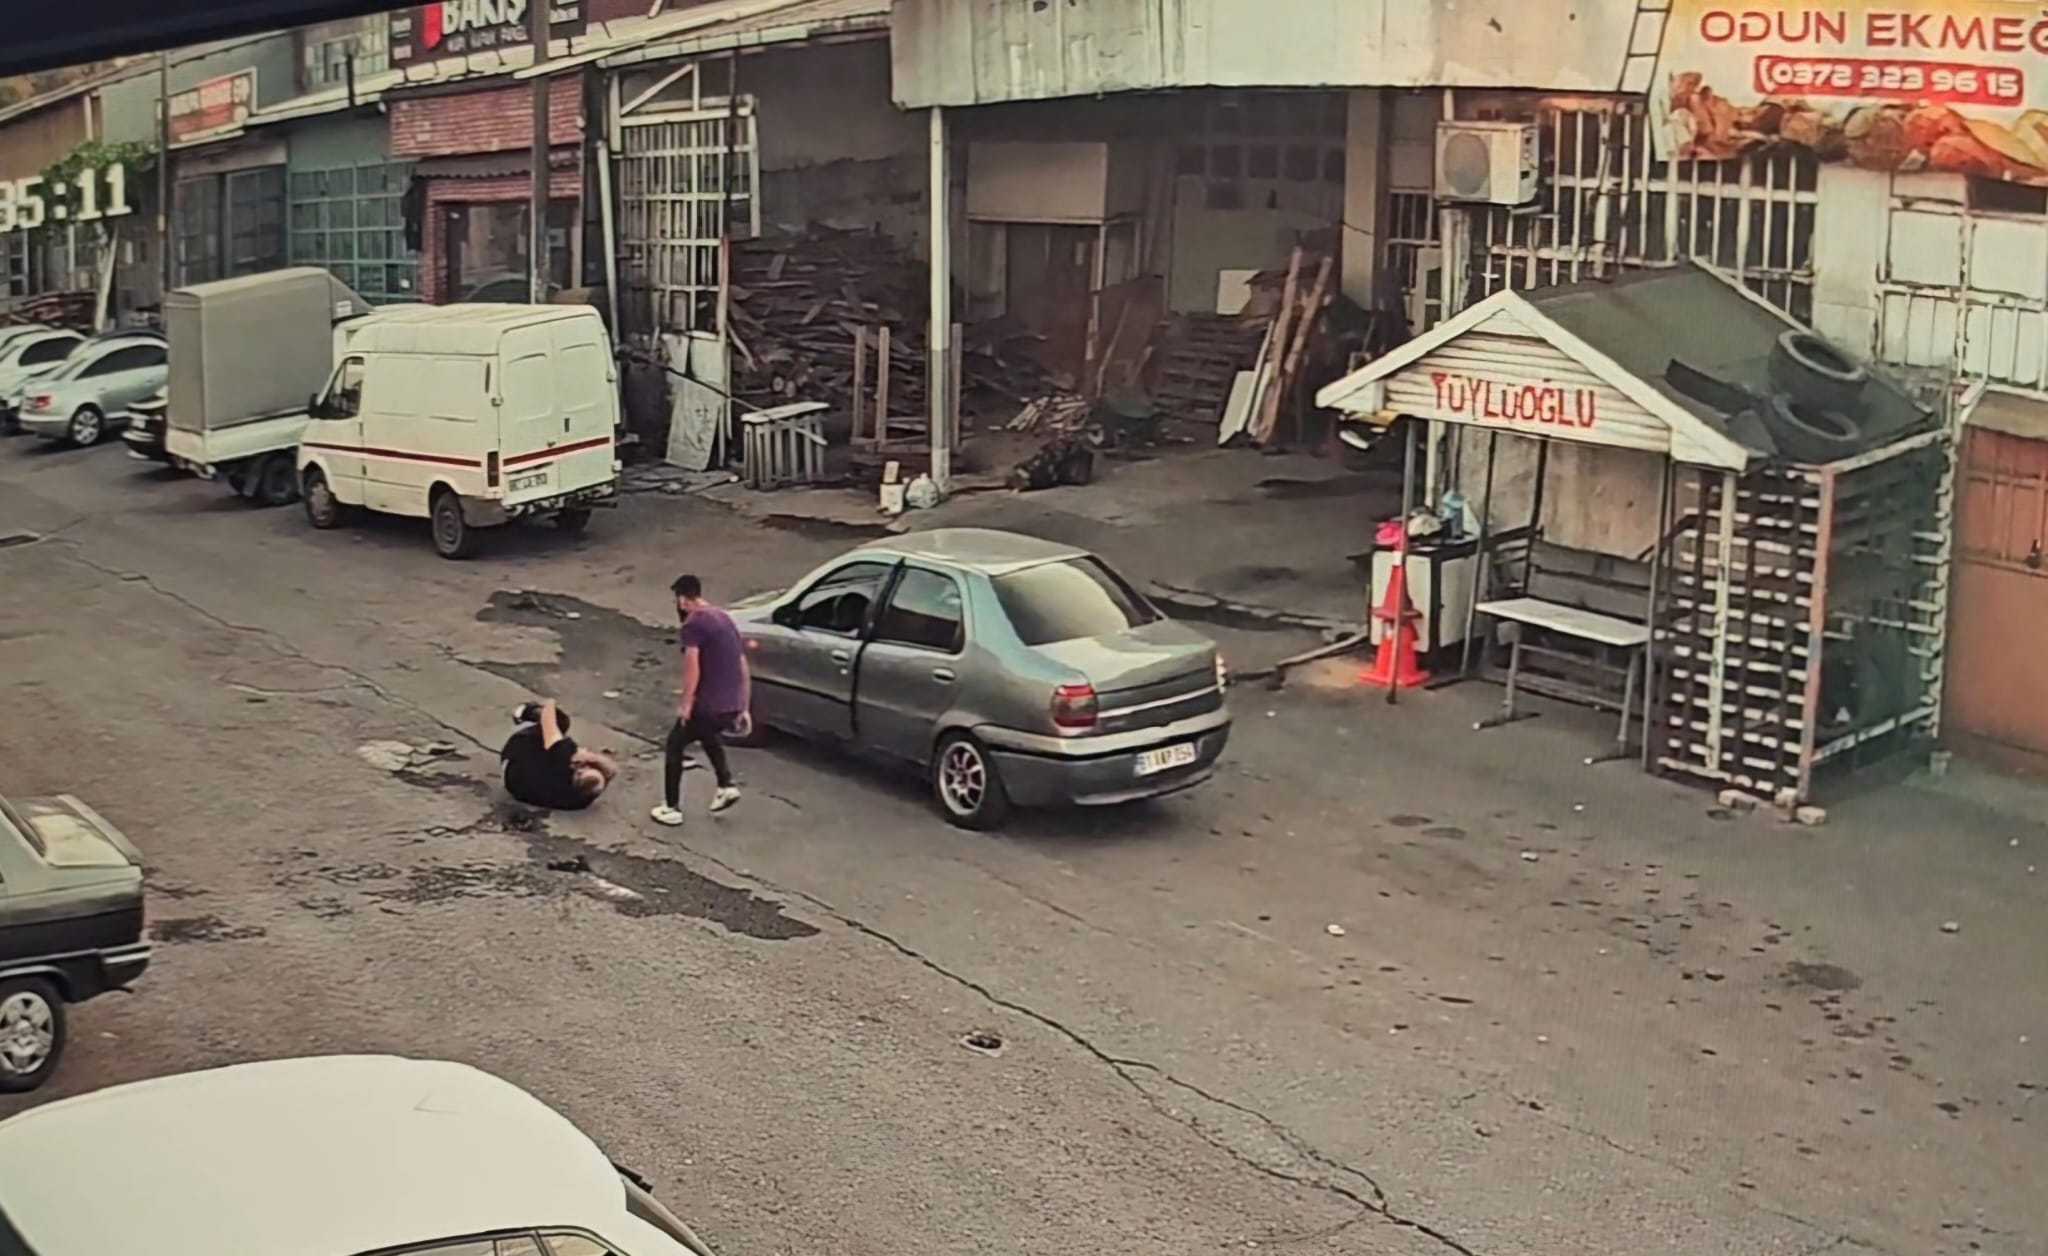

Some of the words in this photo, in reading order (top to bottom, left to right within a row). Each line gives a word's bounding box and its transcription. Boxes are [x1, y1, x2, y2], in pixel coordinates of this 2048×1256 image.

[1700, 10, 1846, 44] ODUN
[1866, 9, 2048, 55] EKMEĞ
[1772, 61, 1853, 88] 0372
[1860, 65, 1924, 90] 323
[1931, 69, 1979, 93] 96
[1986, 71, 2019, 97] 15
